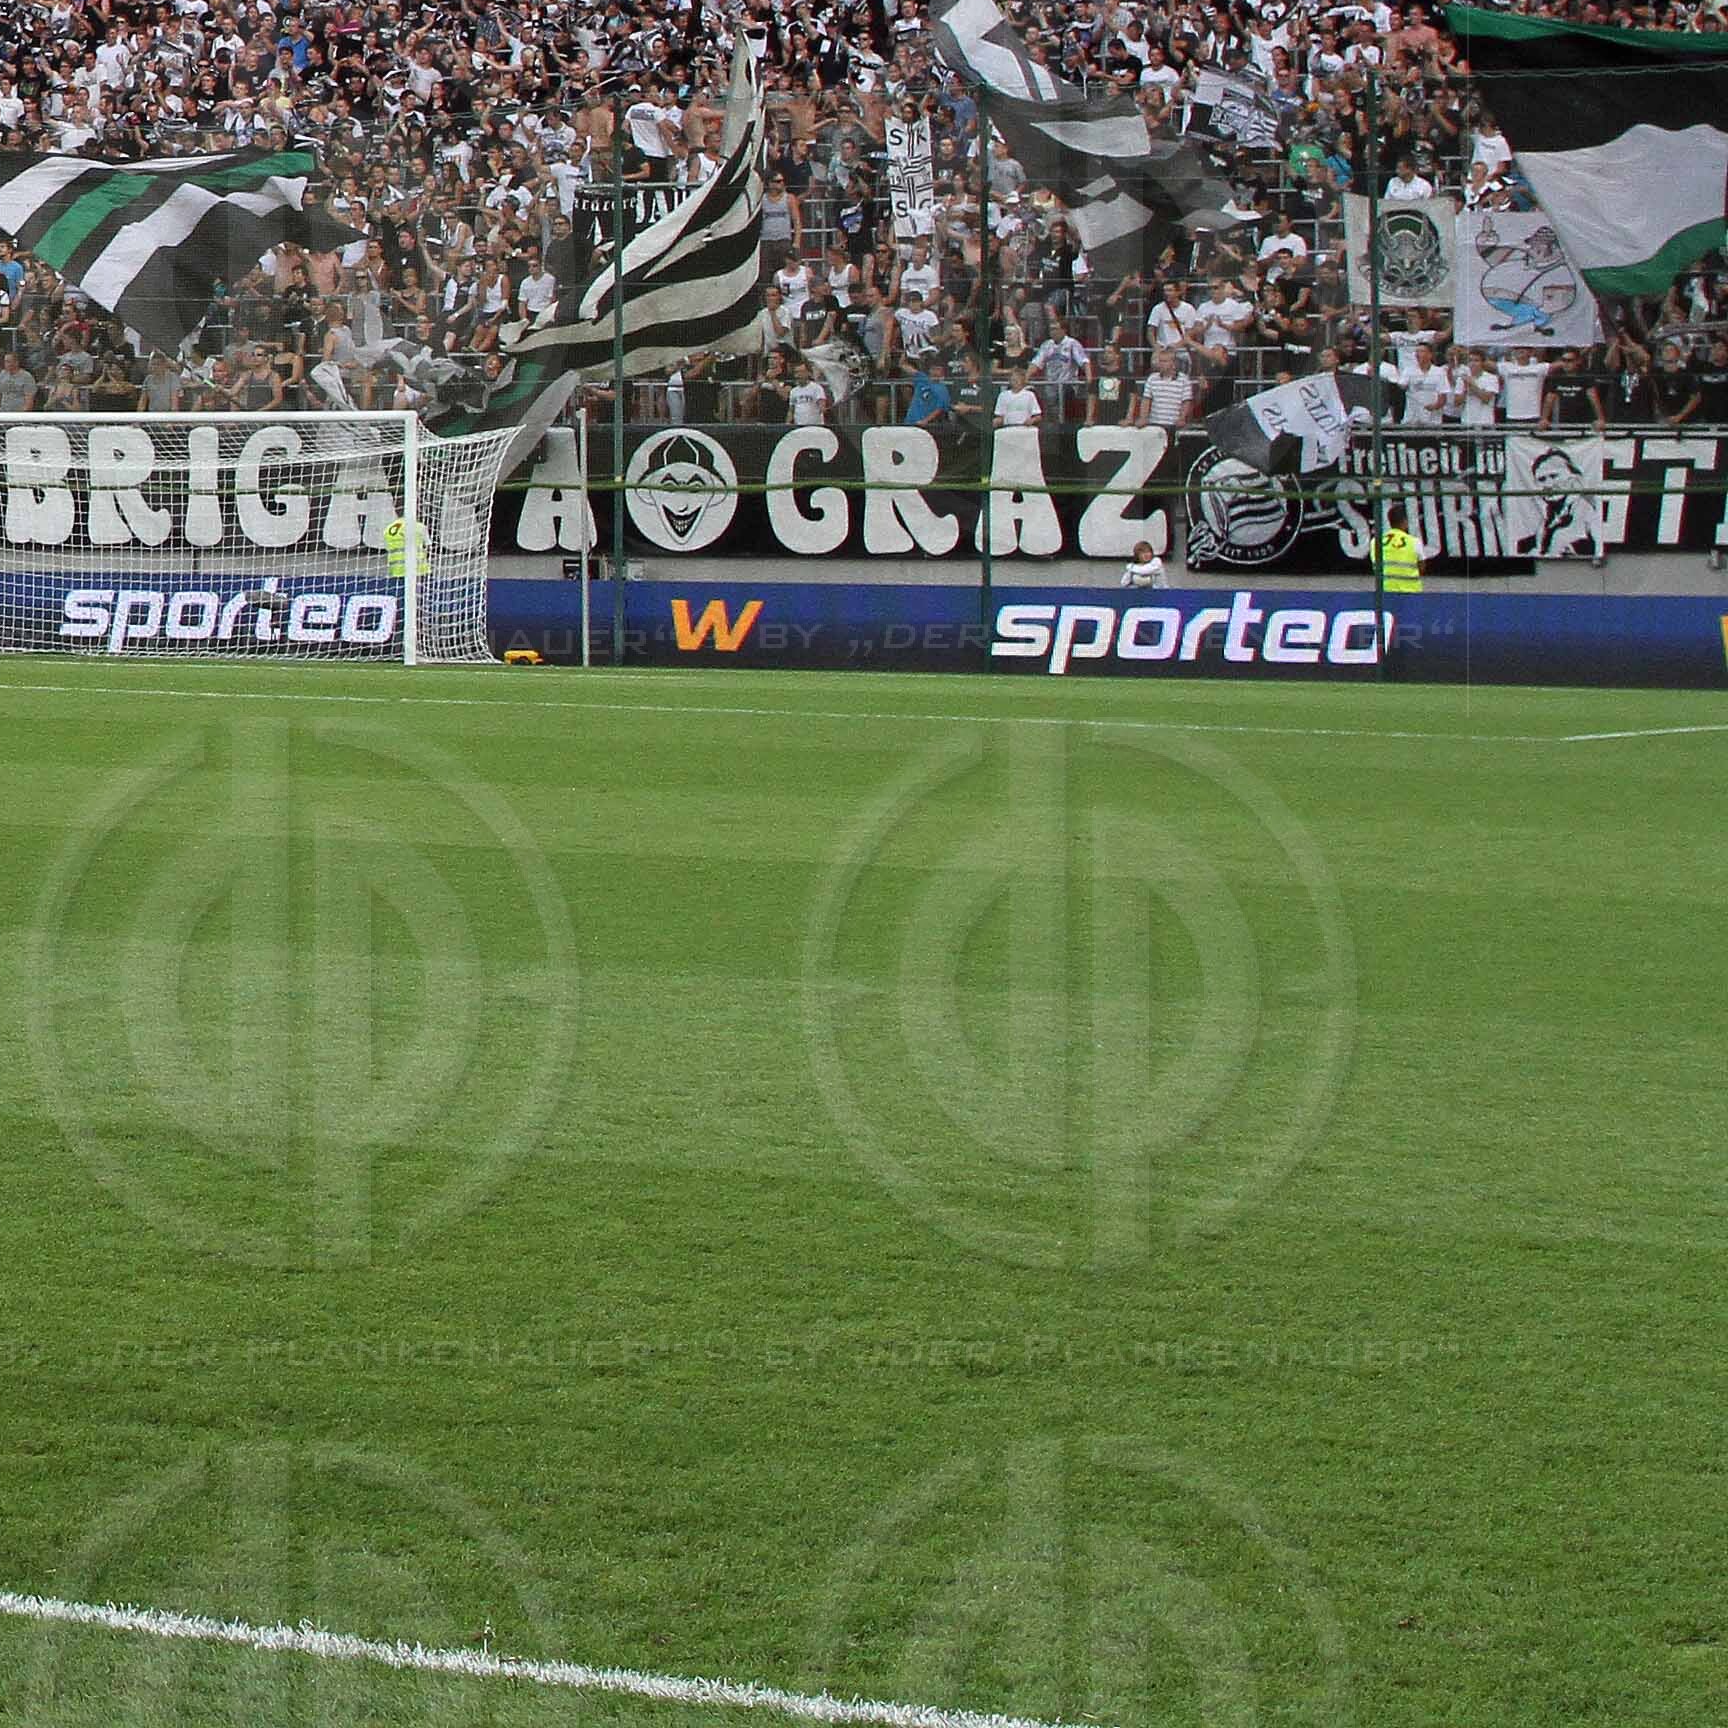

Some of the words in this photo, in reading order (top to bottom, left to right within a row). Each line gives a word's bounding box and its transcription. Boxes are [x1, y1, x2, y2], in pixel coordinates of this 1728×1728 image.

[766, 425, 1169, 557] GRAZ
[59, 577, 398, 653] sporteo
[991, 590, 1395, 674] sporteo
